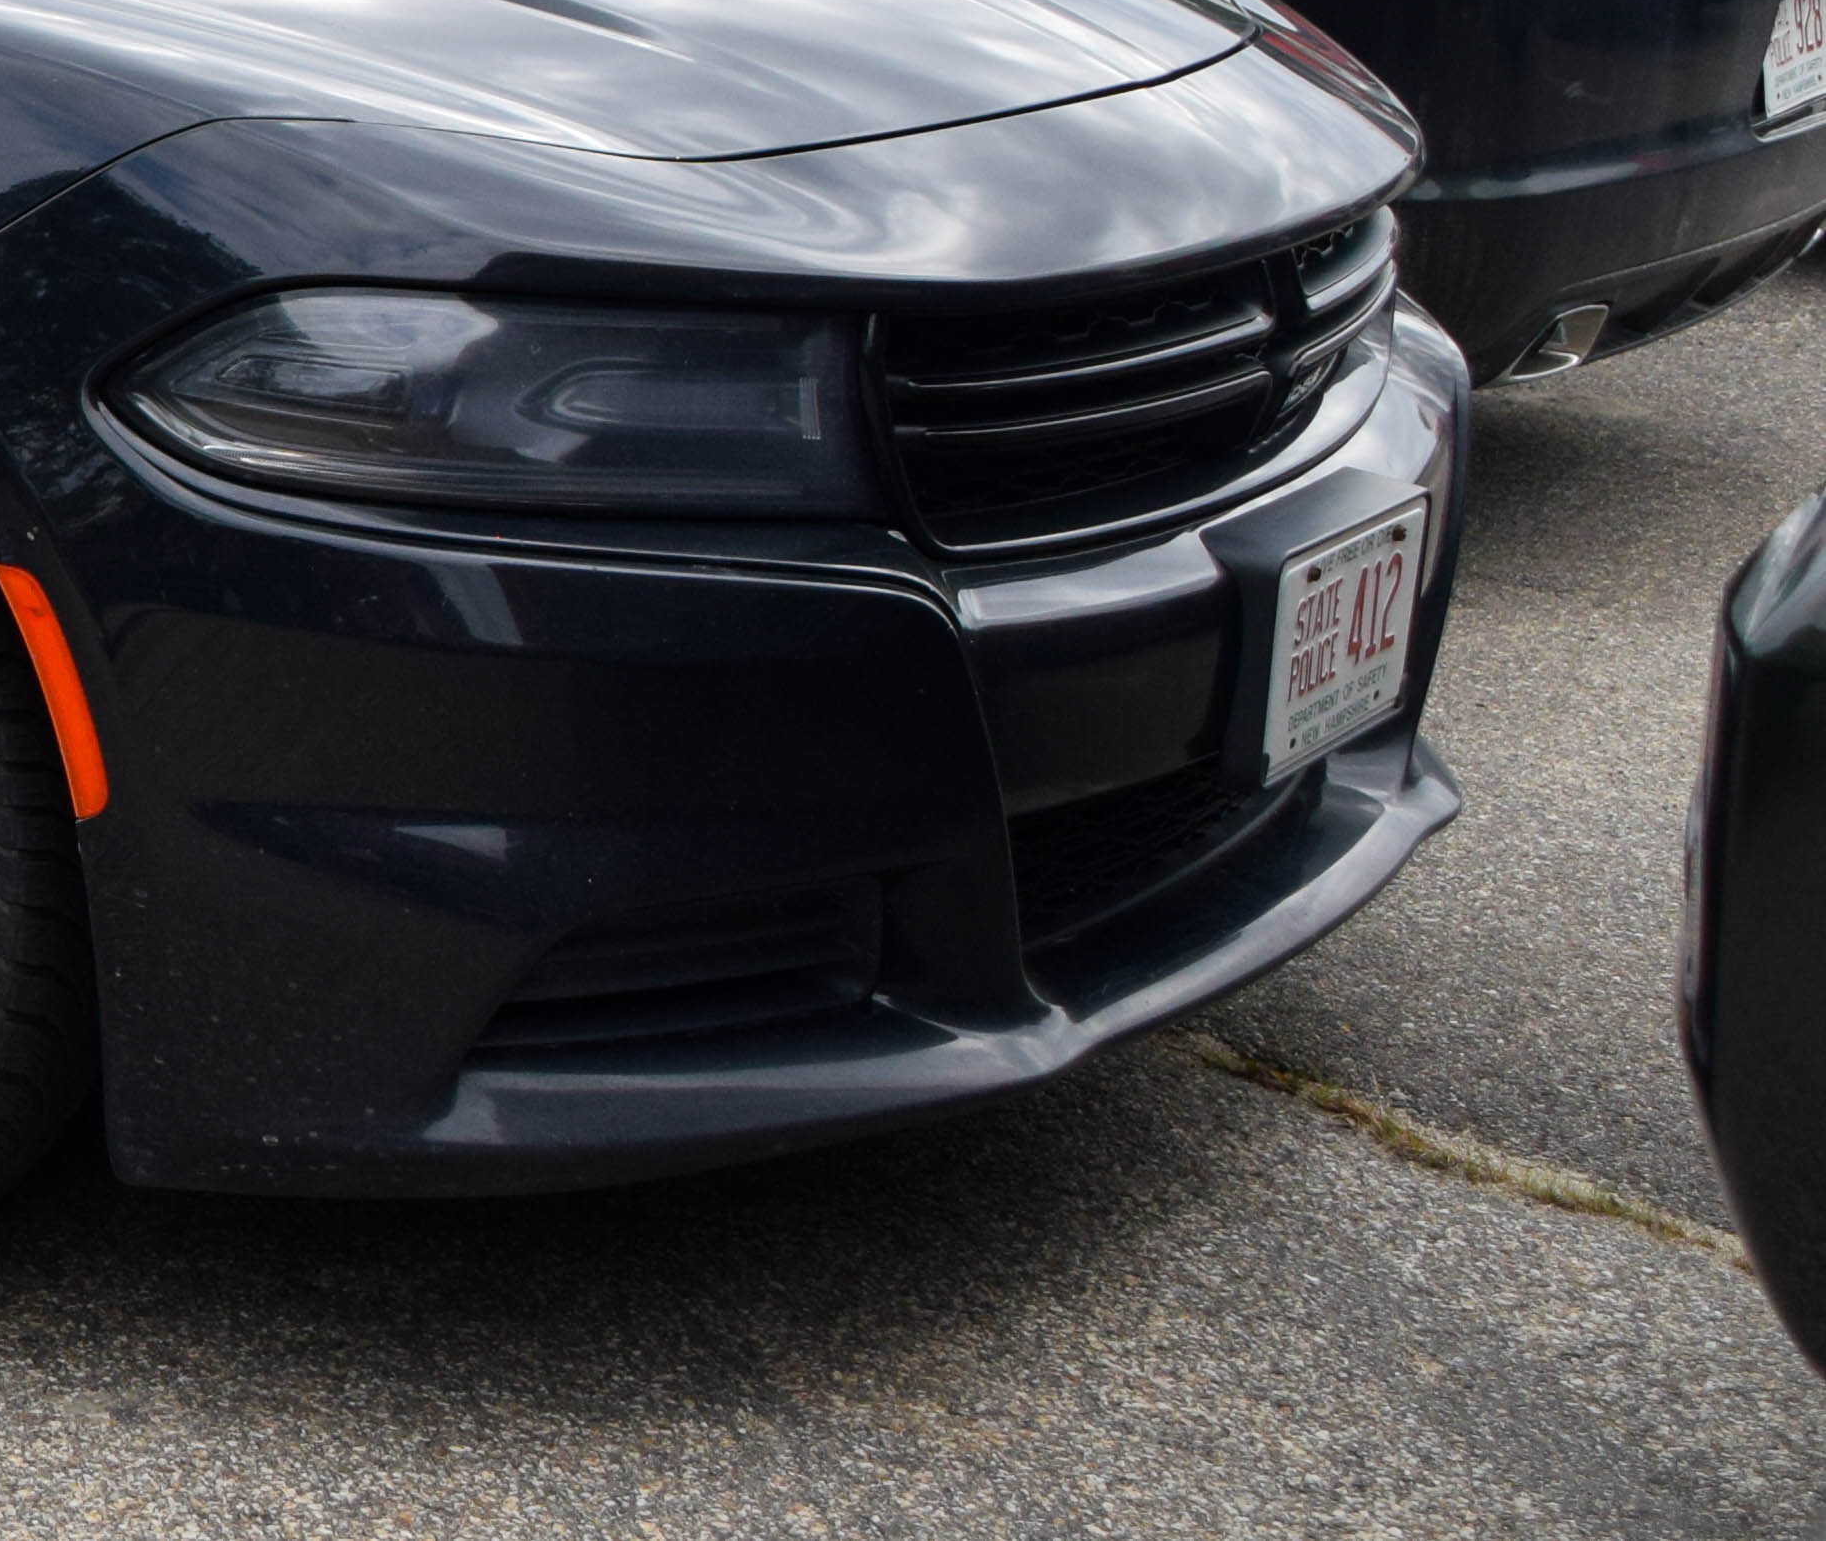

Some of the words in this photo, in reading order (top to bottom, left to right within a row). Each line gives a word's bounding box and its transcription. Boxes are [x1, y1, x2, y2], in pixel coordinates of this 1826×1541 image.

[1294, 577, 1344, 647] STATE
[1348, 551, 1403, 666] 412
[1287, 630, 1339, 703] POLICE
